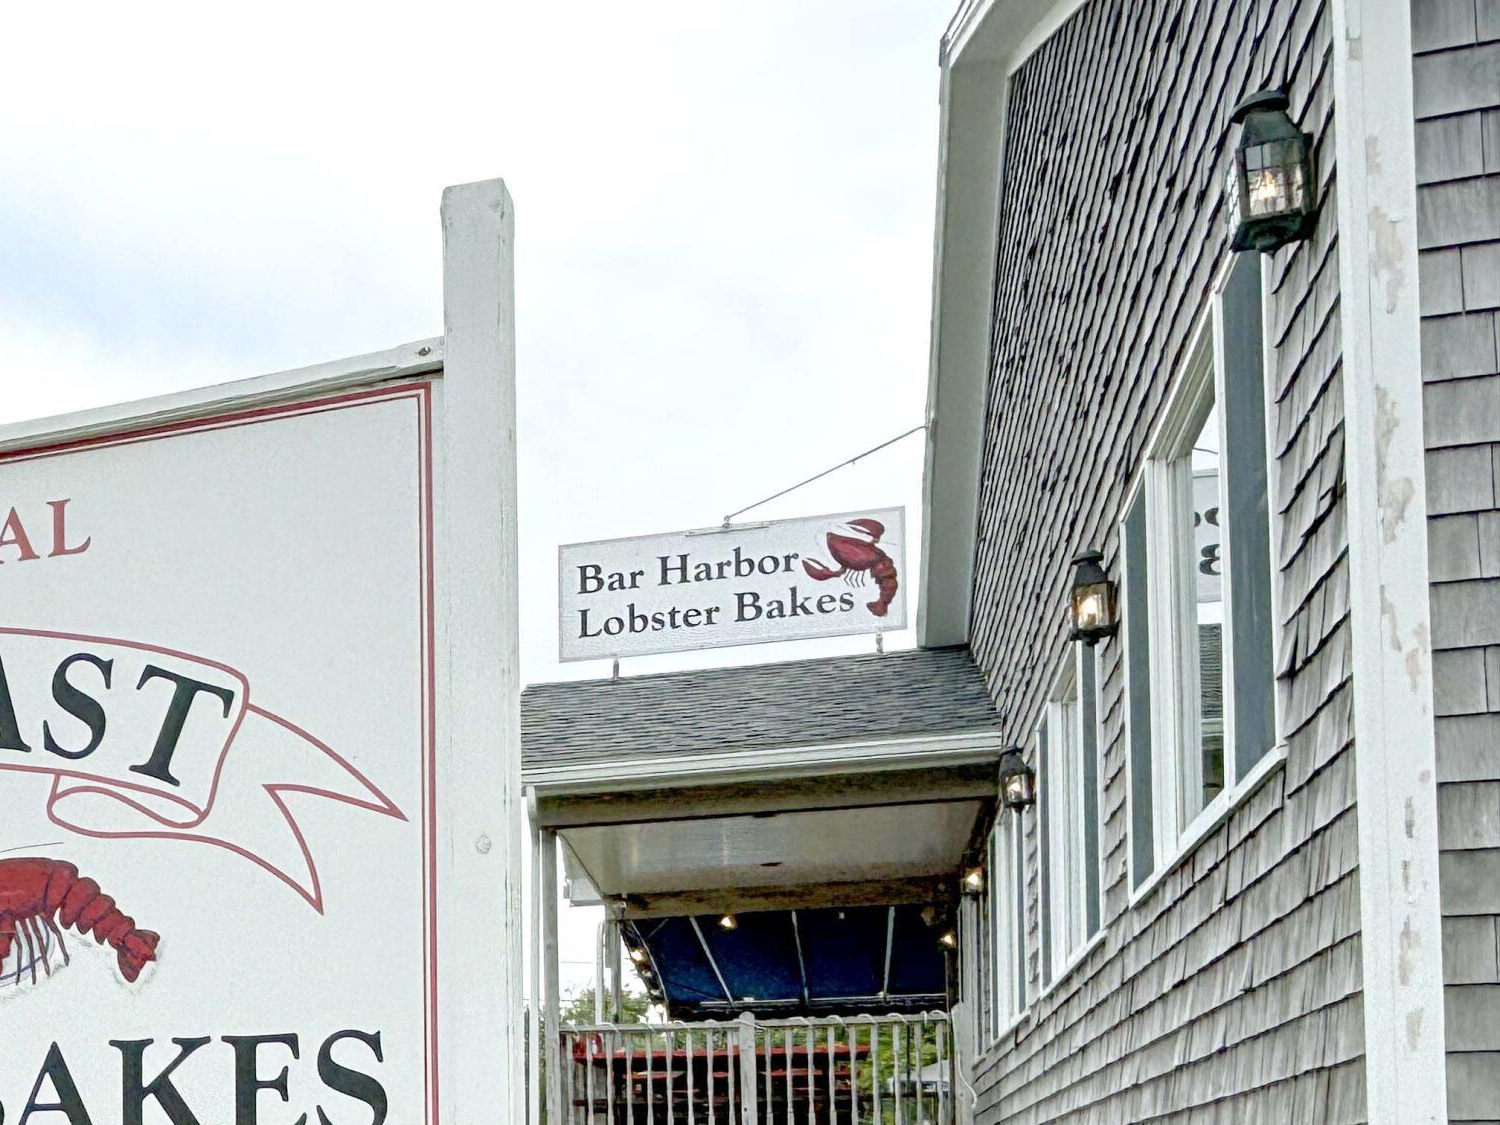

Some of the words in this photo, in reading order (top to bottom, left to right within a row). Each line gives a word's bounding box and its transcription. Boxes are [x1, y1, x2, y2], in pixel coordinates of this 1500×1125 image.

[576, 563, 646, 596] Bar
[656, 546, 800, 587] Harbor
[577, 603, 720, 639] Lobster
[733, 586, 854, 623] Bakes
